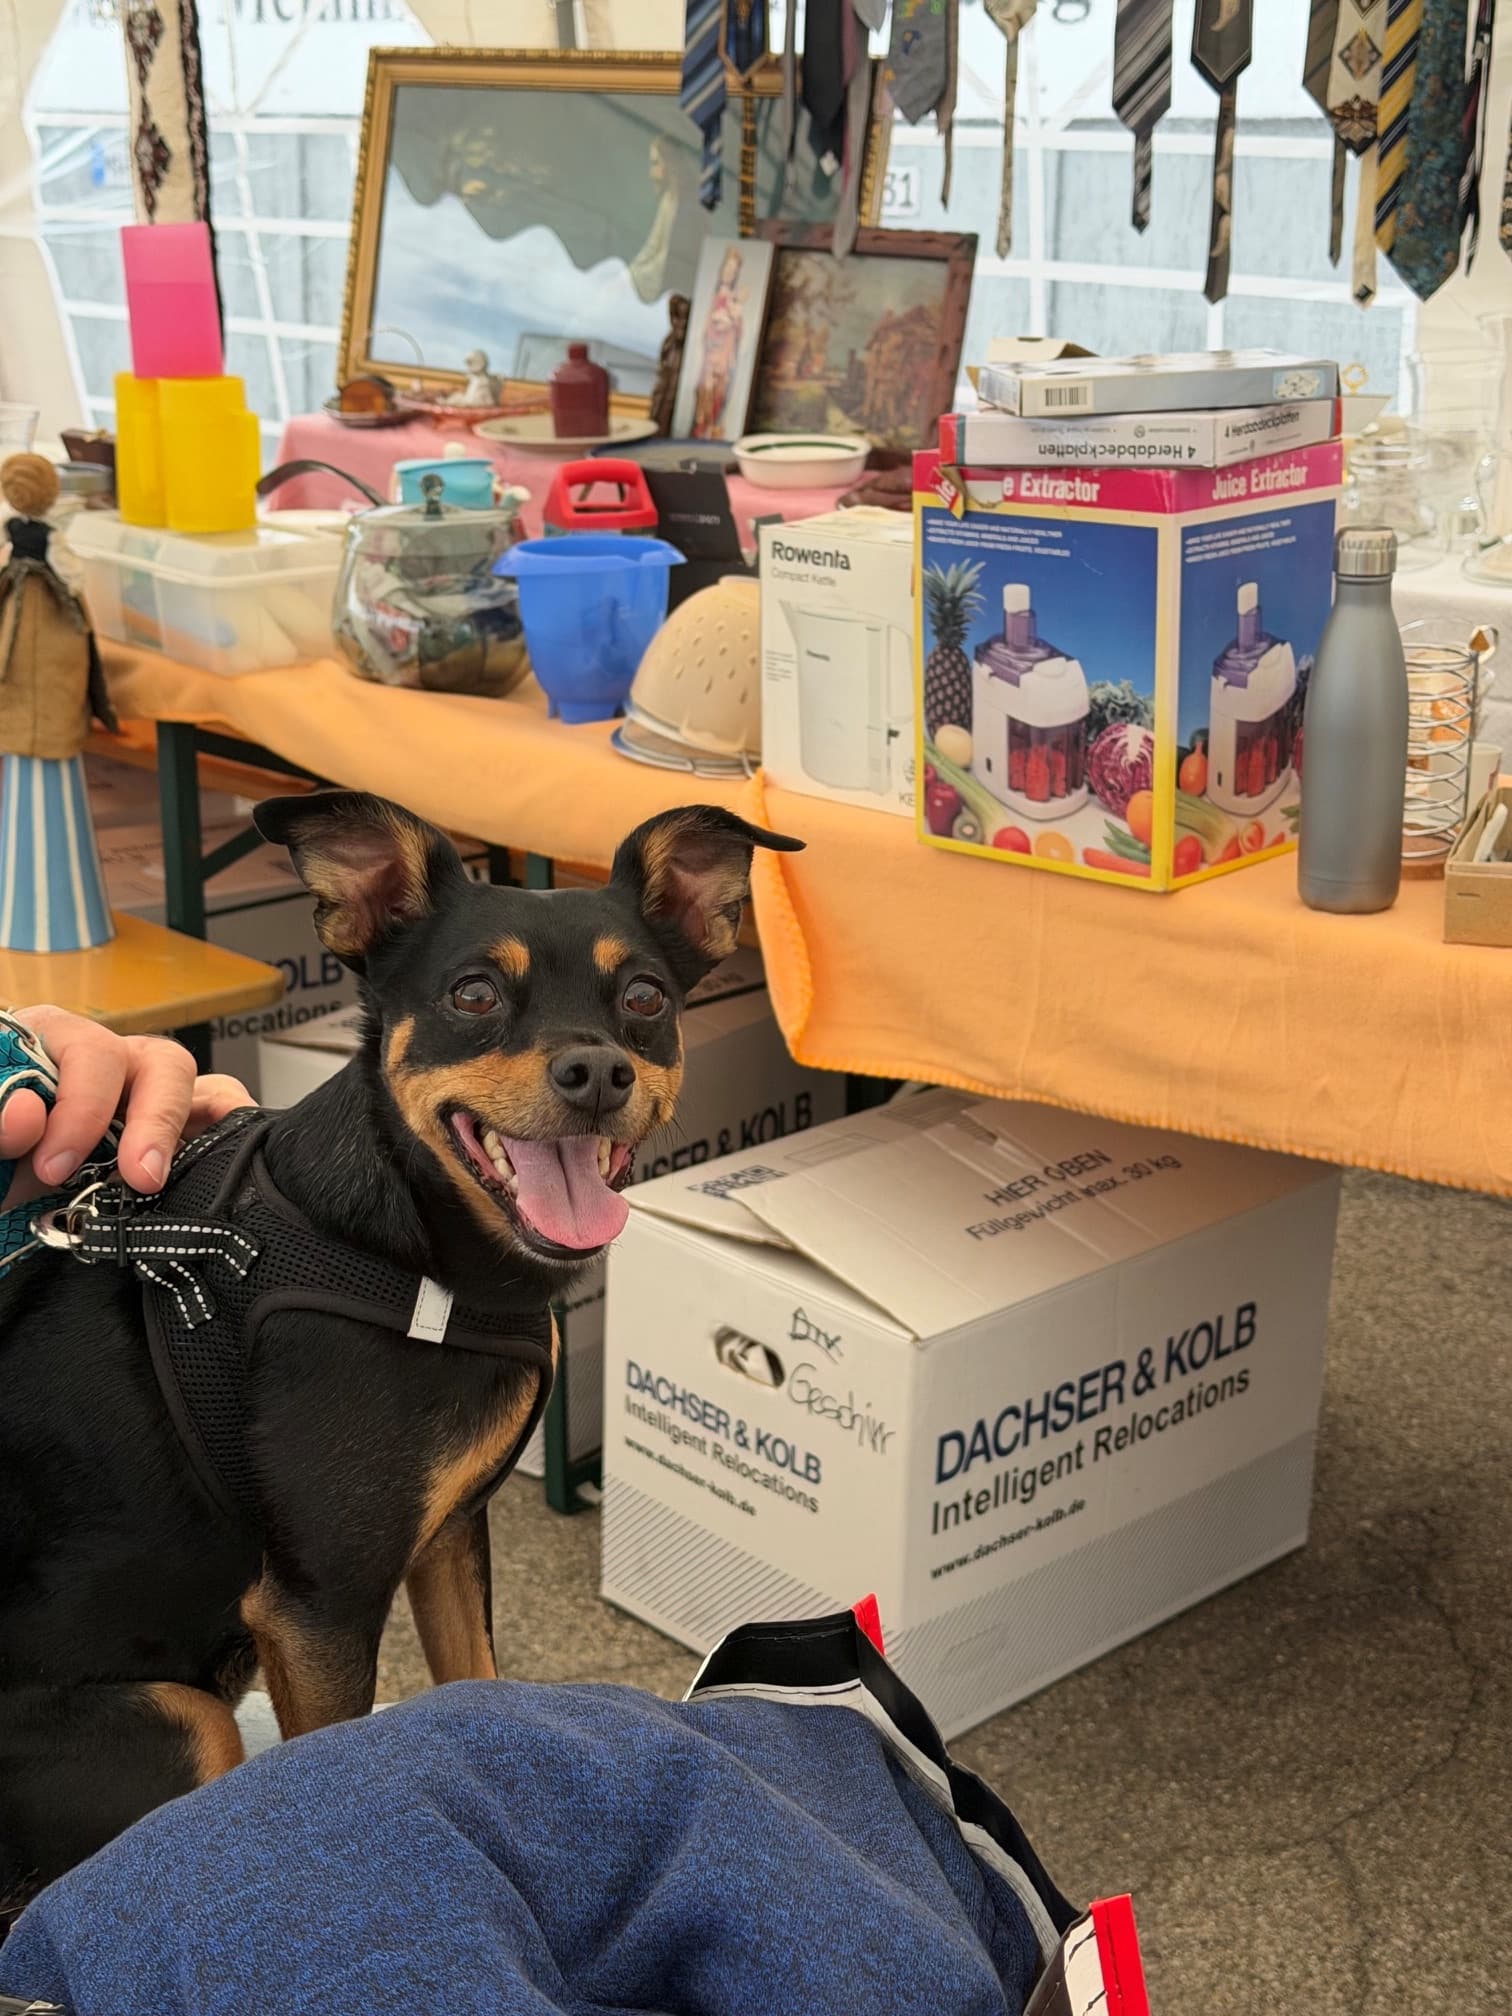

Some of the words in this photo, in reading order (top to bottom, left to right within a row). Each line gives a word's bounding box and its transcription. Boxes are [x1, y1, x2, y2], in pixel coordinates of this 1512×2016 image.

[1038, 441, 1183, 458] Herdabdeckplatten
[1187, 445, 1196, 458] 4
[1020, 472, 1100, 502] Extractor
[1212, 472, 1247, 501] Juice
[1250, 462, 1309, 493] Extractor
[771, 541, 851, 571] Rowenta
[741, 1091, 813, 1152] KOLB
[983, 1174, 1048, 1207] HIER
[1043, 1149, 1112, 1182] OBEN
[626, 1359, 730, 1441] DACHSER
[733, 1418, 750, 1451] &
[755, 1427, 821, 1485] KOLB
[935, 1359, 1127, 1485] DACHSER
[1131, 1346, 1156, 1397] &
[1162, 1301, 1257, 1384] KOLB
[624, 1393, 707, 1456] Intelligent
[711, 1440, 819, 1514] Relocations
[624, 1435, 757, 1517] www.dachser-kolb.de
[931, 1440, 1084, 1536] Intelligent
[1092, 1367, 1250, 1463] Relocations
[930, 1499, 1086, 1580] www.dachser-kolb.de
